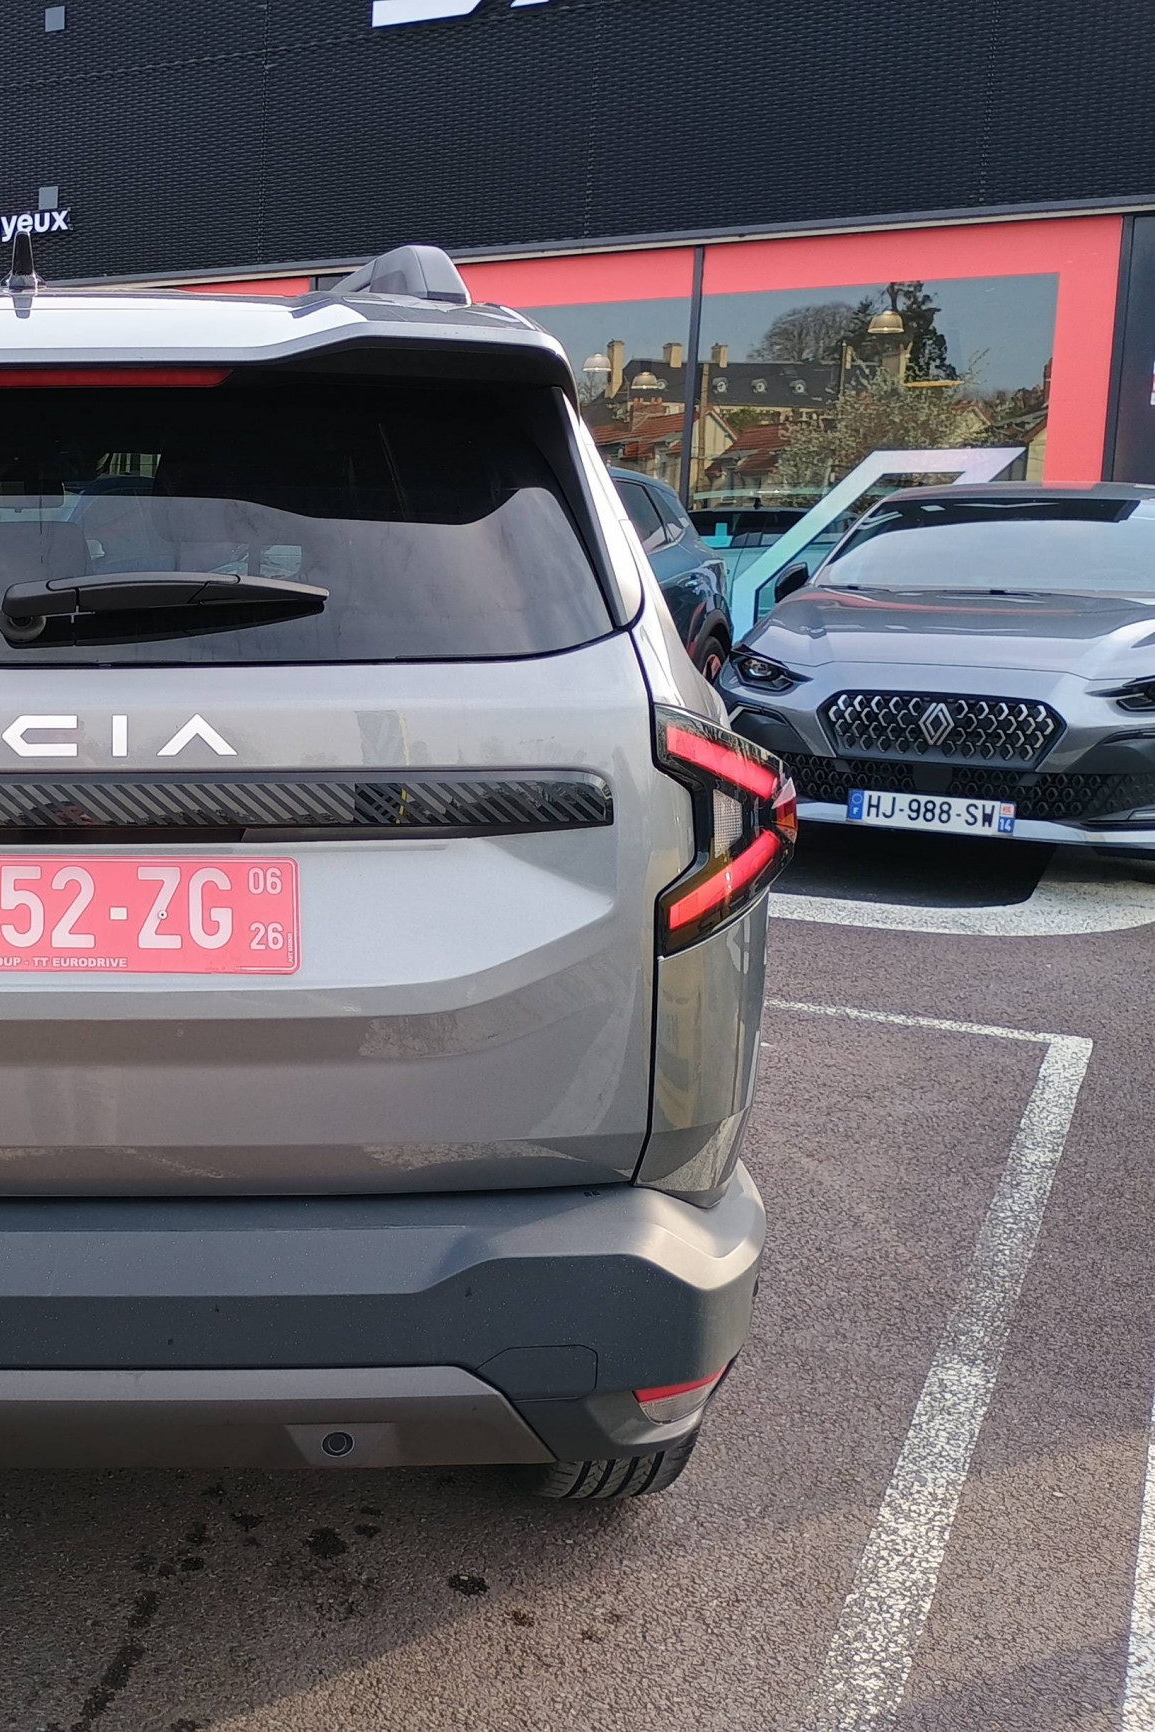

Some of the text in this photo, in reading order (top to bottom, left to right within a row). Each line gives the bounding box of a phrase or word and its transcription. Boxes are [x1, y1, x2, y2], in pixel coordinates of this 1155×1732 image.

[866, 794, 996, 828] HJ-988-SW
[999, 818, 1012, 832] 14
[248, 866, 283, 895] 06
[248, 921, 285, 951] 26
[33, 956, 49, 968] TT
[52, 957, 128, 968] EURODRIVE
